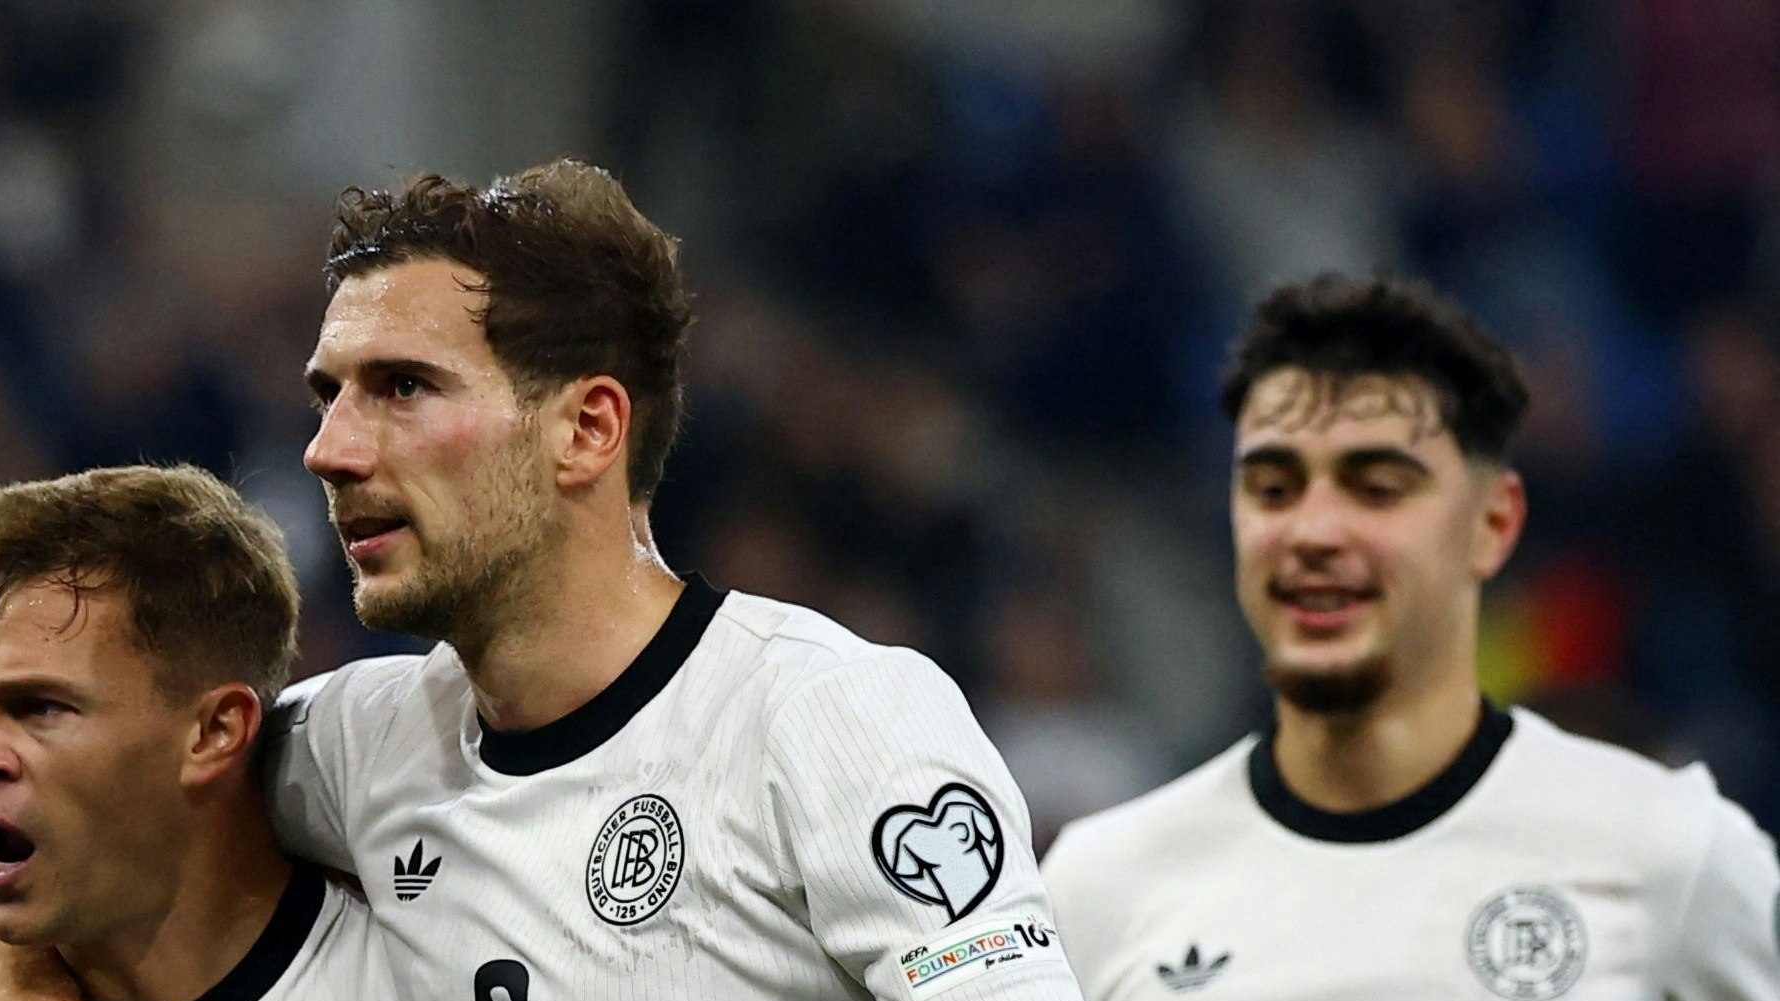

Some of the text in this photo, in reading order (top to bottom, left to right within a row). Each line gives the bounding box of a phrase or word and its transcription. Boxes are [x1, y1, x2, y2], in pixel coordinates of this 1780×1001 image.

[591, 800, 679, 908] DEUTSCHER FUSSBALL-BUND
[615, 905, 637, 919] 125
[900, 945, 930, 966] UEFA
[906, 933, 1018, 984] FOUNDATION
